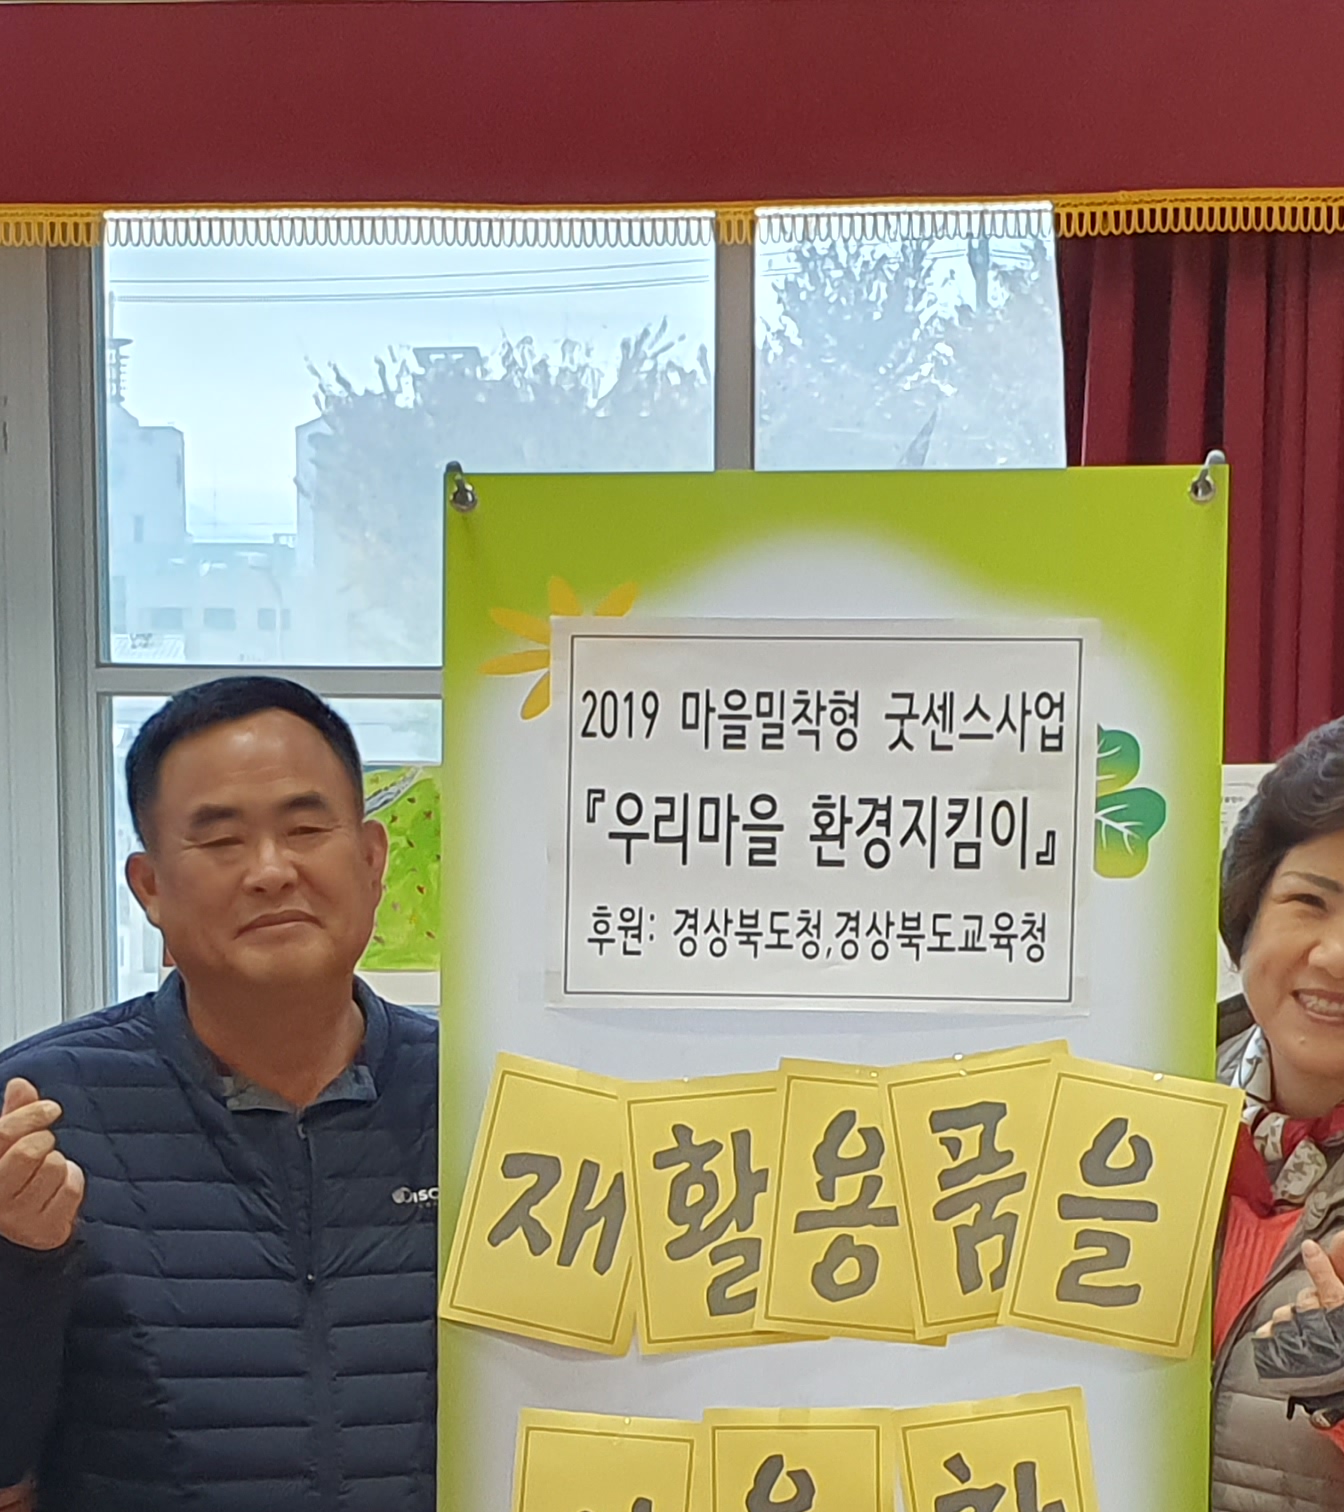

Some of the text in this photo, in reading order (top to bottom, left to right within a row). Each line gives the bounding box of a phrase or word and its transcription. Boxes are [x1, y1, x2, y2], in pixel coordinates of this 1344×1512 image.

[580, 688, 1067, 754] 2019 마을밀착형 굿센스사업
[586, 788, 1057, 871] 『우리마을 환경지킴이』
[587, 906, 656, 957] 후원:
[487, 1101, 1159, 1317] 재활용품을
